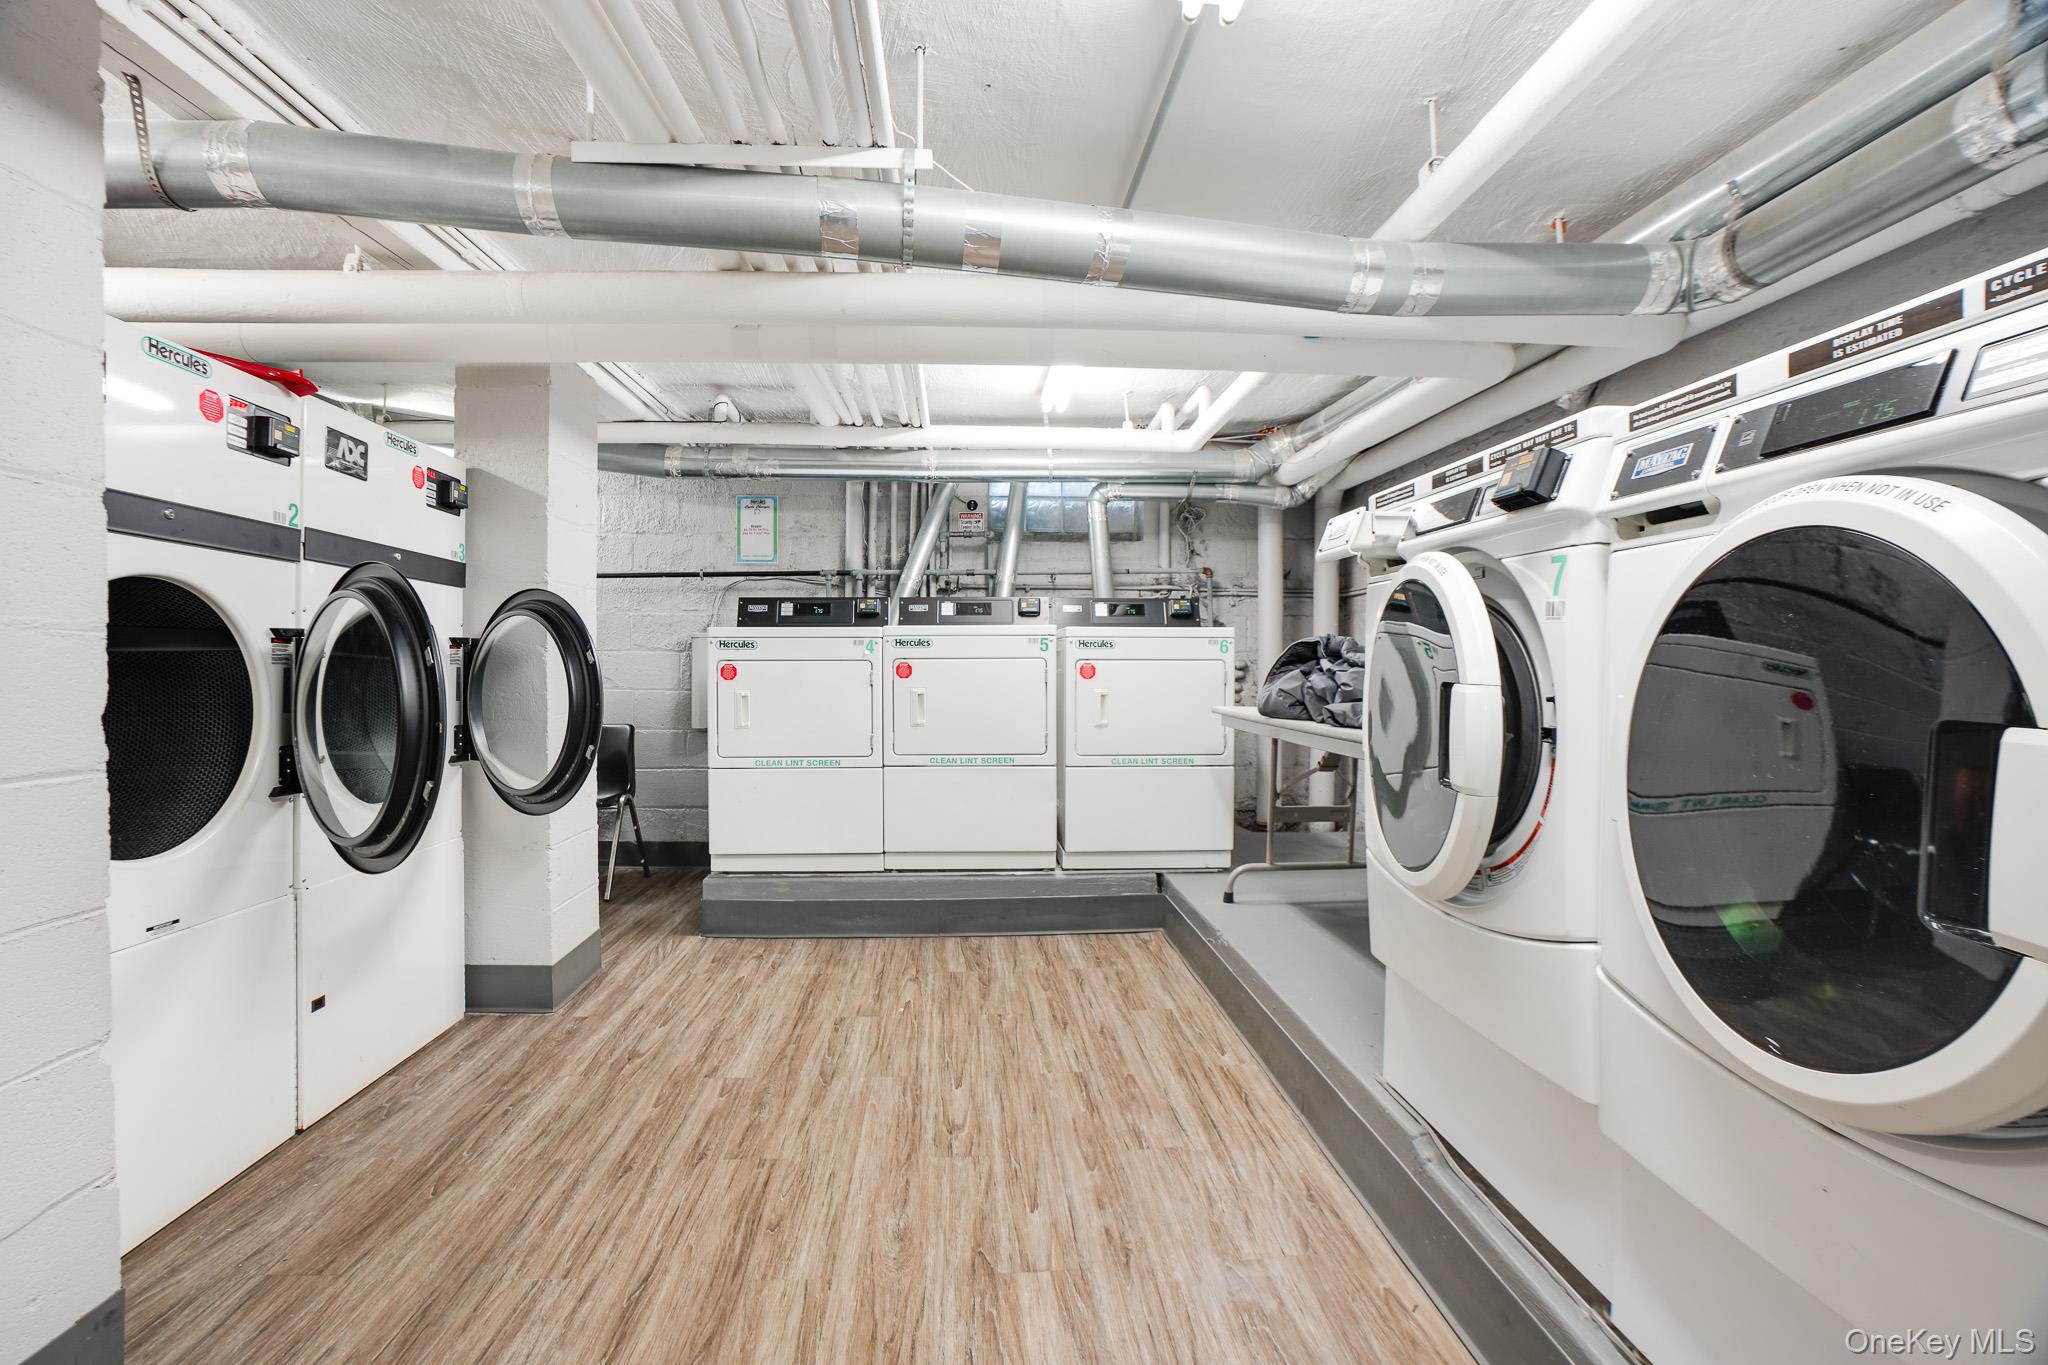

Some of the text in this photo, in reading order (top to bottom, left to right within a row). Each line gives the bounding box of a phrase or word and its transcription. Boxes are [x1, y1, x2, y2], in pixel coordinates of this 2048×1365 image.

[1991, 262, 2047, 291] CYCLE
[1833, 315, 1904, 347] DISPLAY TIME
[1833, 327, 1904, 358] IS ESTIMATED
[148, 336, 208, 375] Hercules
[336, 436, 366, 467] ADC
[387, 432, 417, 455] Hercules
[1825, 481, 1868, 492] WHEN
[1865, 482, 1900, 496] NOT
[1894, 488, 1919, 501] IN
[1913, 493, 1951, 512] USE
[288, 503, 298, 528] 2
[459, 544, 465, 561] 3
[1551, 555, 1568, 596] 7
[719, 640, 756, 648] Hercules
[865, 640, 875, 654] 4
[895, 639, 930, 647] Hercules
[1040, 638, 1049, 651] 5
[1078, 640, 1113, 648] Hercules
[1220, 640, 1229, 654] 6
